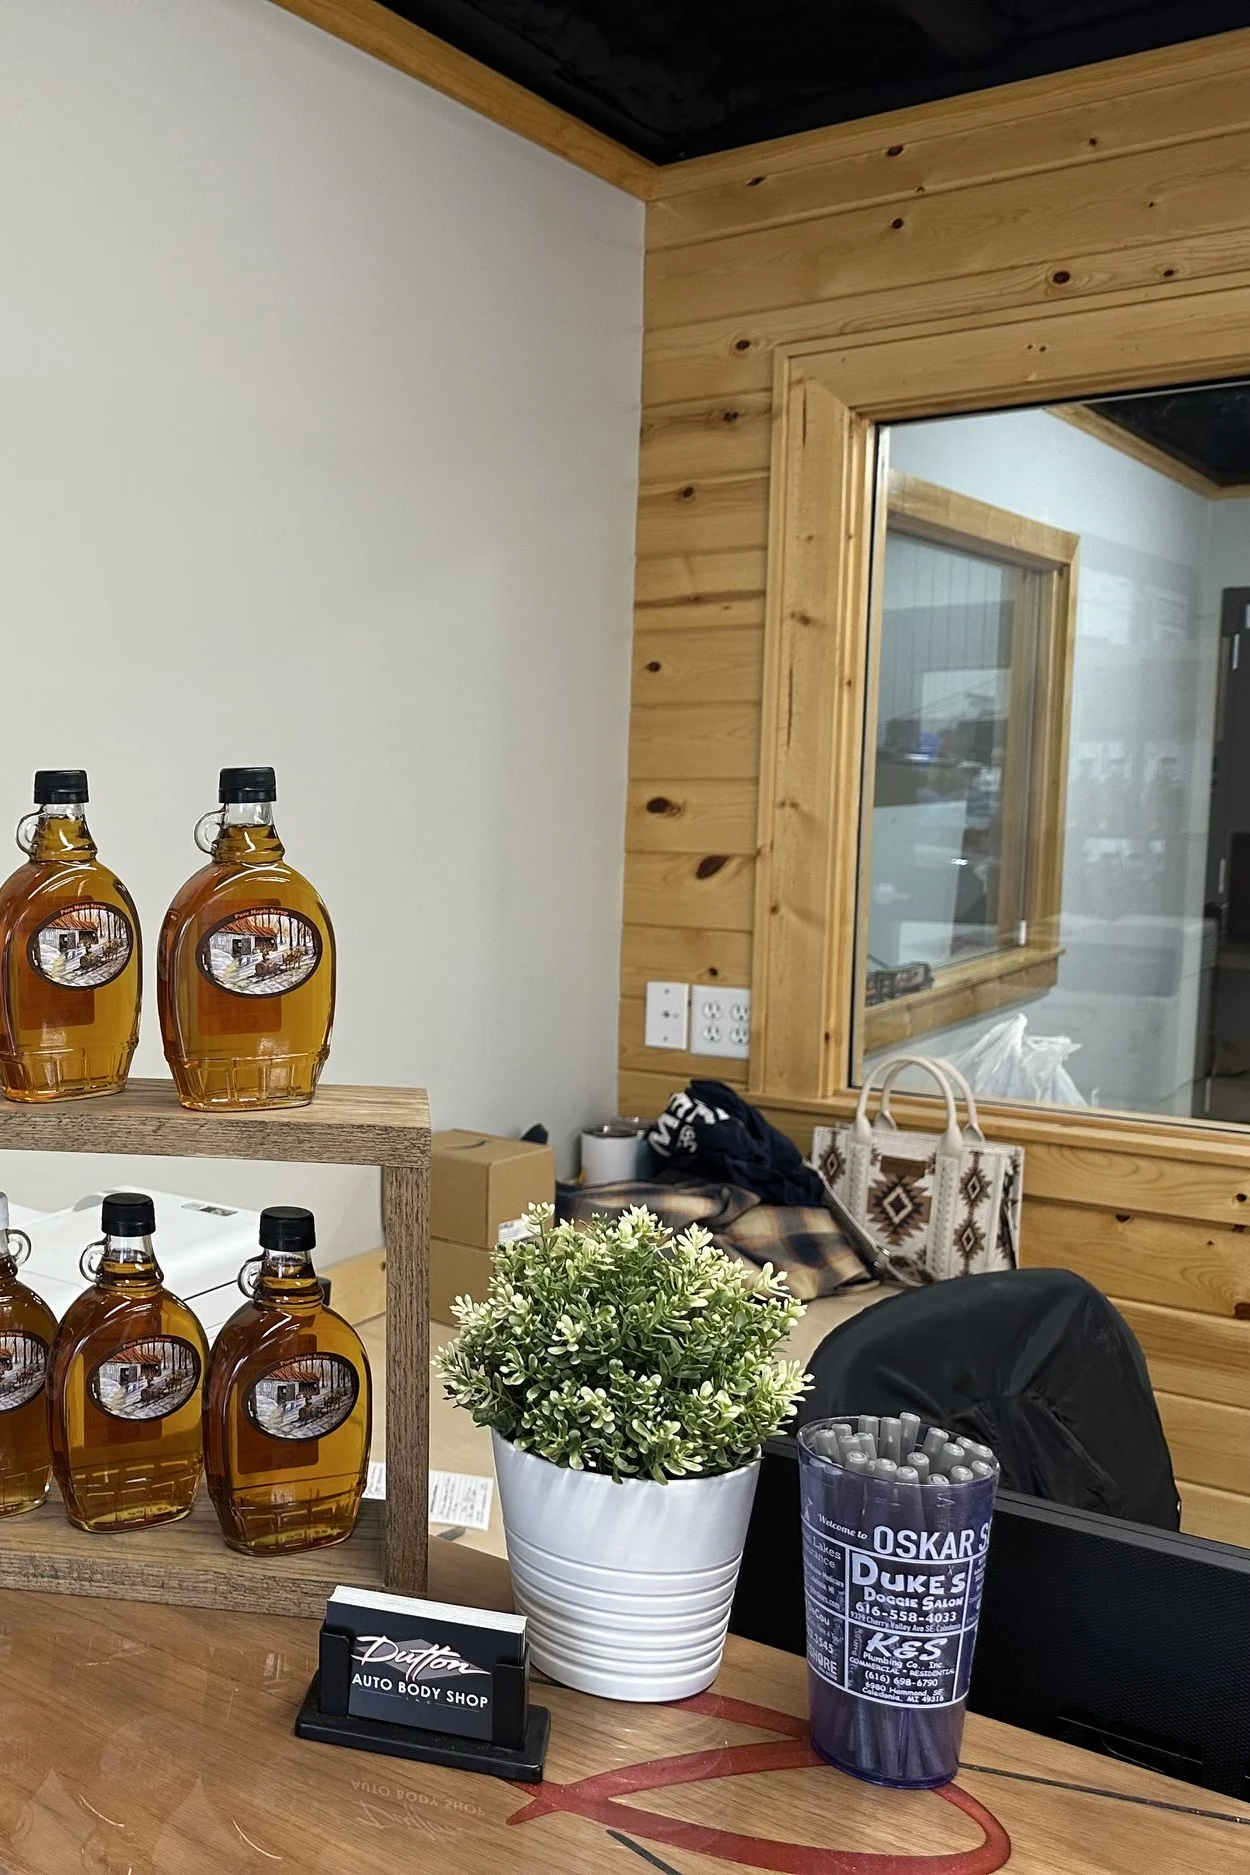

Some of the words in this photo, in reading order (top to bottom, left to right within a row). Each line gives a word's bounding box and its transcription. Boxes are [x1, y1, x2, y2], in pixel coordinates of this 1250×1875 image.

[60, 907, 73, 915] Pure
[250, 908, 268, 916] Maple
[270, 908, 289, 916] Syrup
[122, 1341, 136, 1349] Pure
[818, 1513, 856, 1537] Welcome
[857, 1530, 868, 1540] to
[873, 1525, 975, 1560] OSKAR
[812, 1536, 842, 1560] Lakes
[855, 1601, 957, 1623] 616-558-4033
[866, 1614, 890, 1628] Cherry
[890, 1622, 911, 1632] Valley
[912, 1624, 925, 1632] Ave
[865, 1631, 948, 1660] K&S
[351, 1634, 491, 1682] Dutton
[849, 1656, 900, 1675] COMMERCIAL
[909, 1668, 956, 1677] RESIDENTIAL
[863, 1651, 903, 1669] Plumbing
[929, 1661, 945, 1669] Inc.
[865, 1670, 890, 1684] (616)
[893, 1677, 938, 1687] 698-6790
[865, 1681, 886, 1692] 6980
[352, 1673, 393, 1691] AUTO
[398, 1681, 442, 1700] BODY
[446, 1690, 489, 1708] SHOP
[906, 1695, 919, 1703] MI
